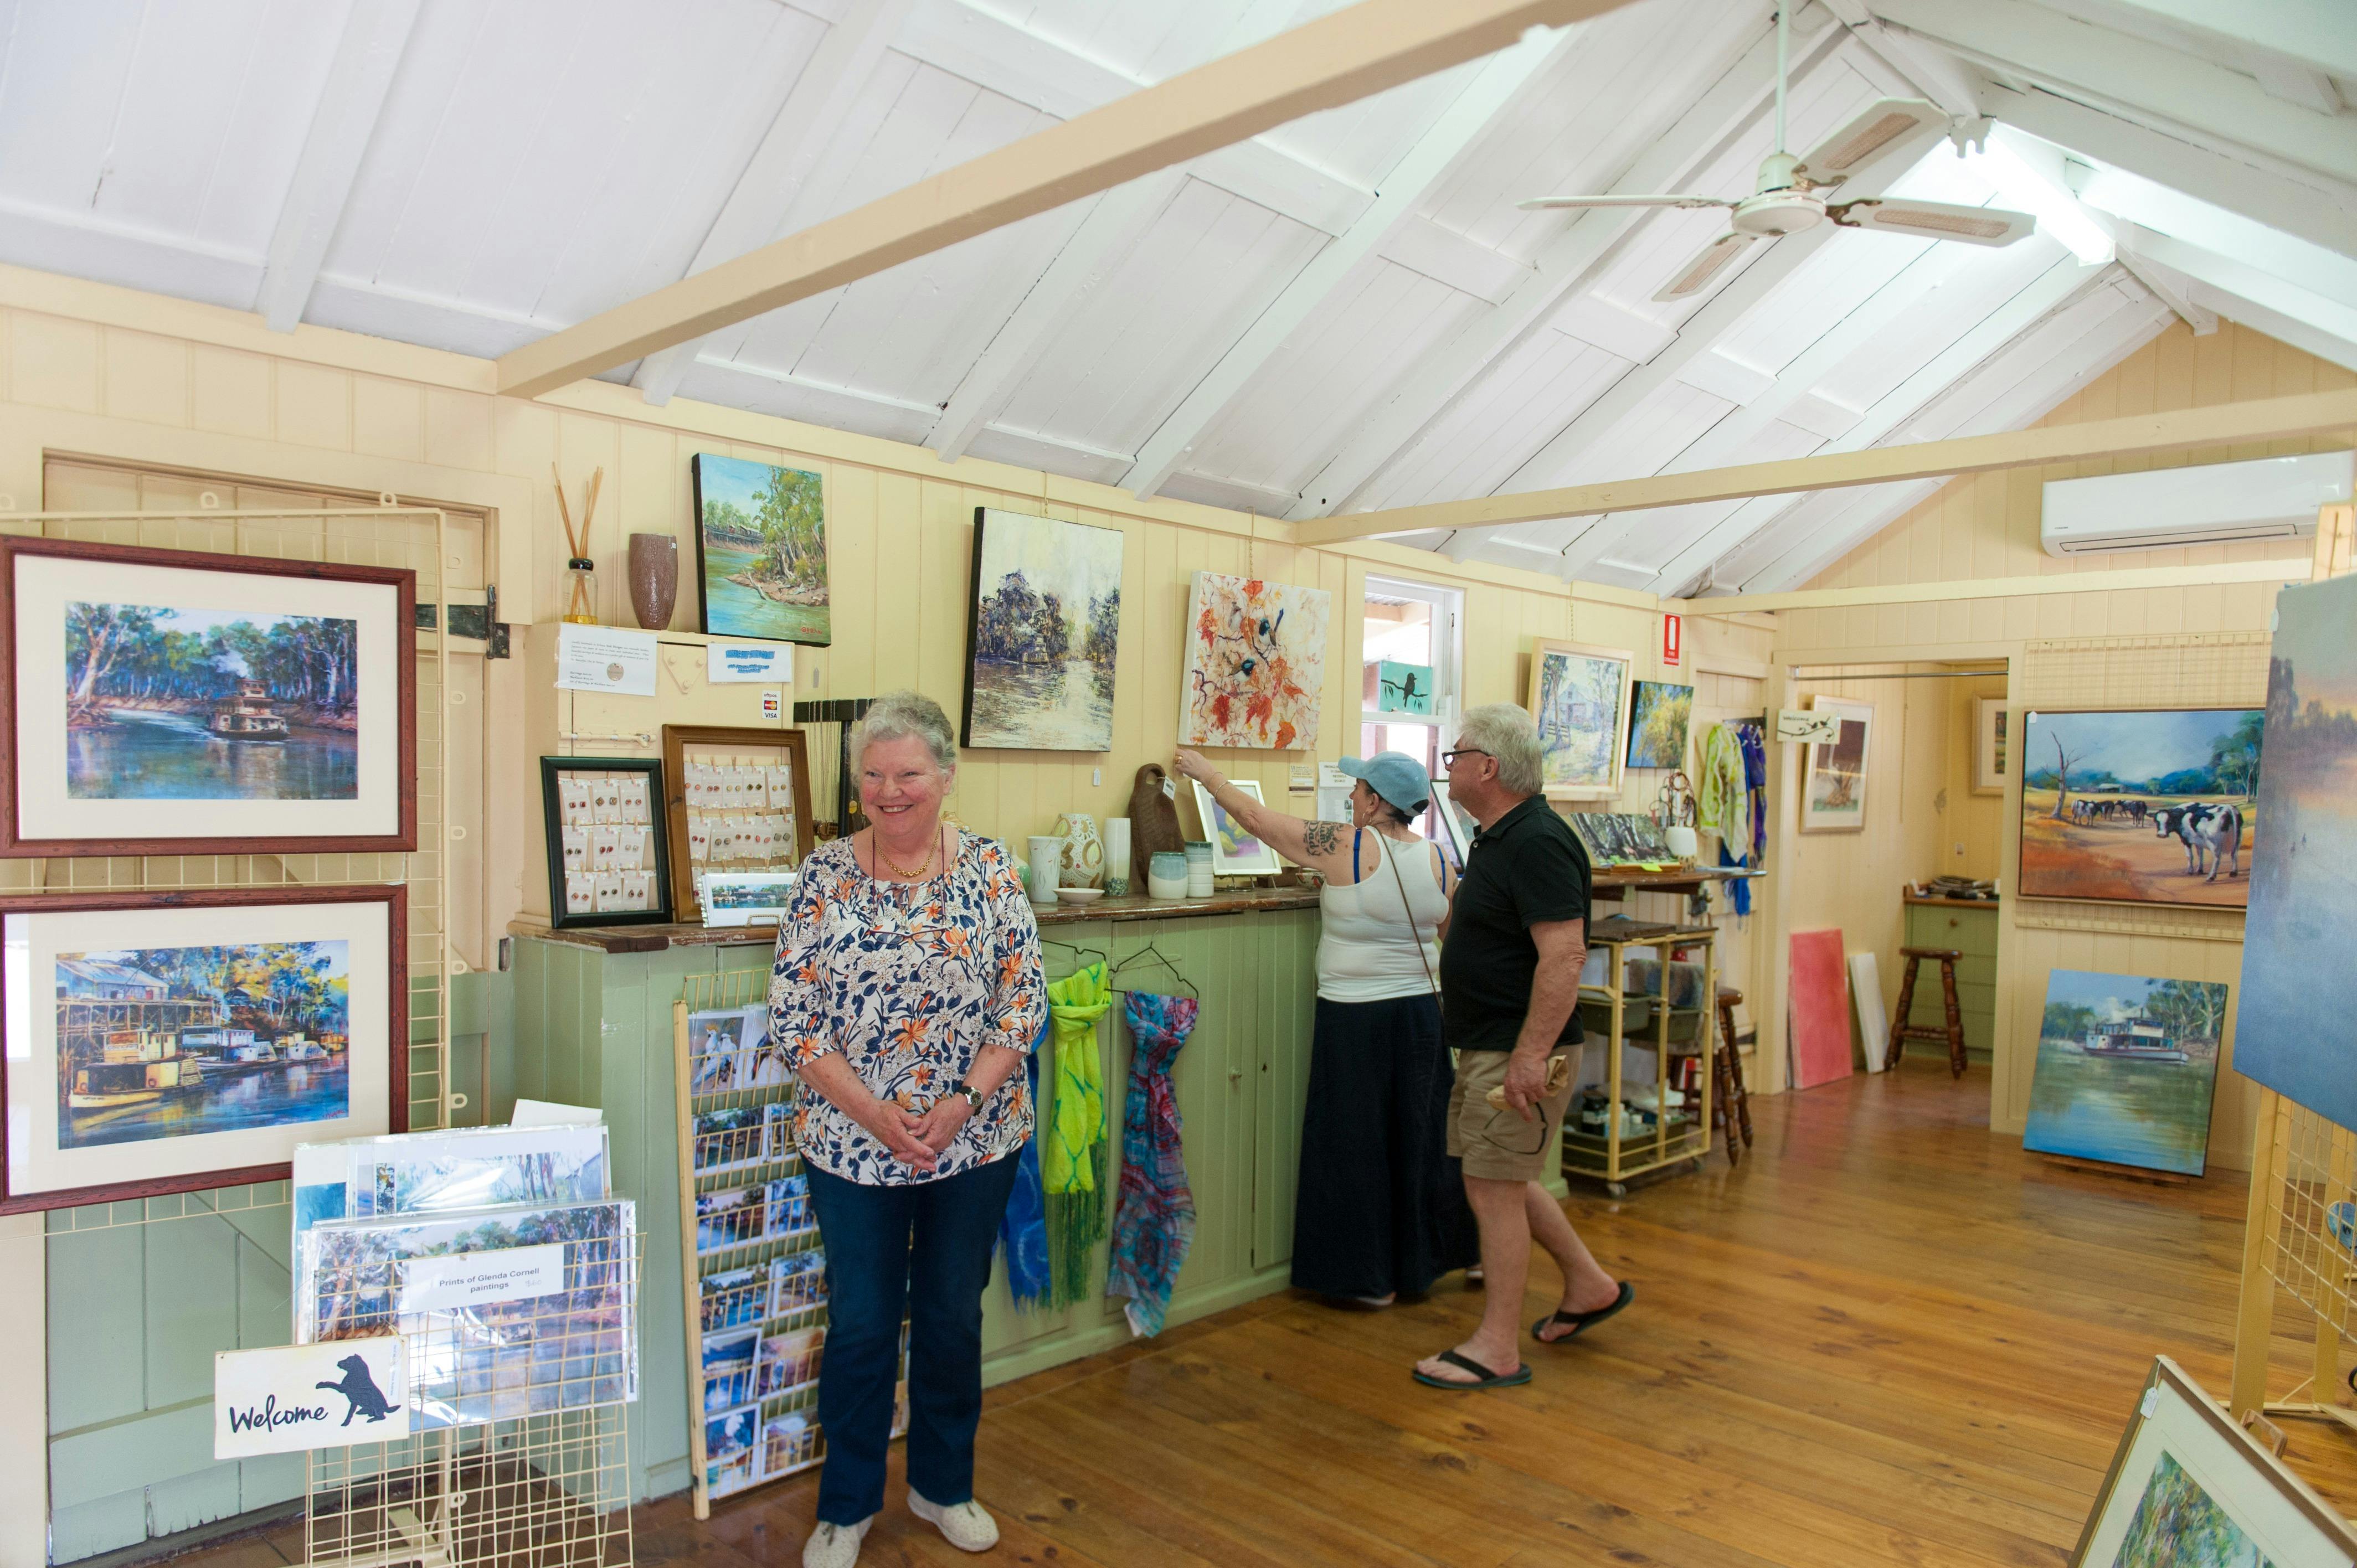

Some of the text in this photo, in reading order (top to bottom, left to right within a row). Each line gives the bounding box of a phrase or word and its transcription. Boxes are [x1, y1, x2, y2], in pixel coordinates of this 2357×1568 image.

[439, 1278, 464, 1287] Prints
[478, 1272, 507, 1281] Glenda
[510, 1267, 539, 1277] Cornell
[470, 1281, 509, 1293] paintings
[230, 1394, 329, 1433] Welcome
